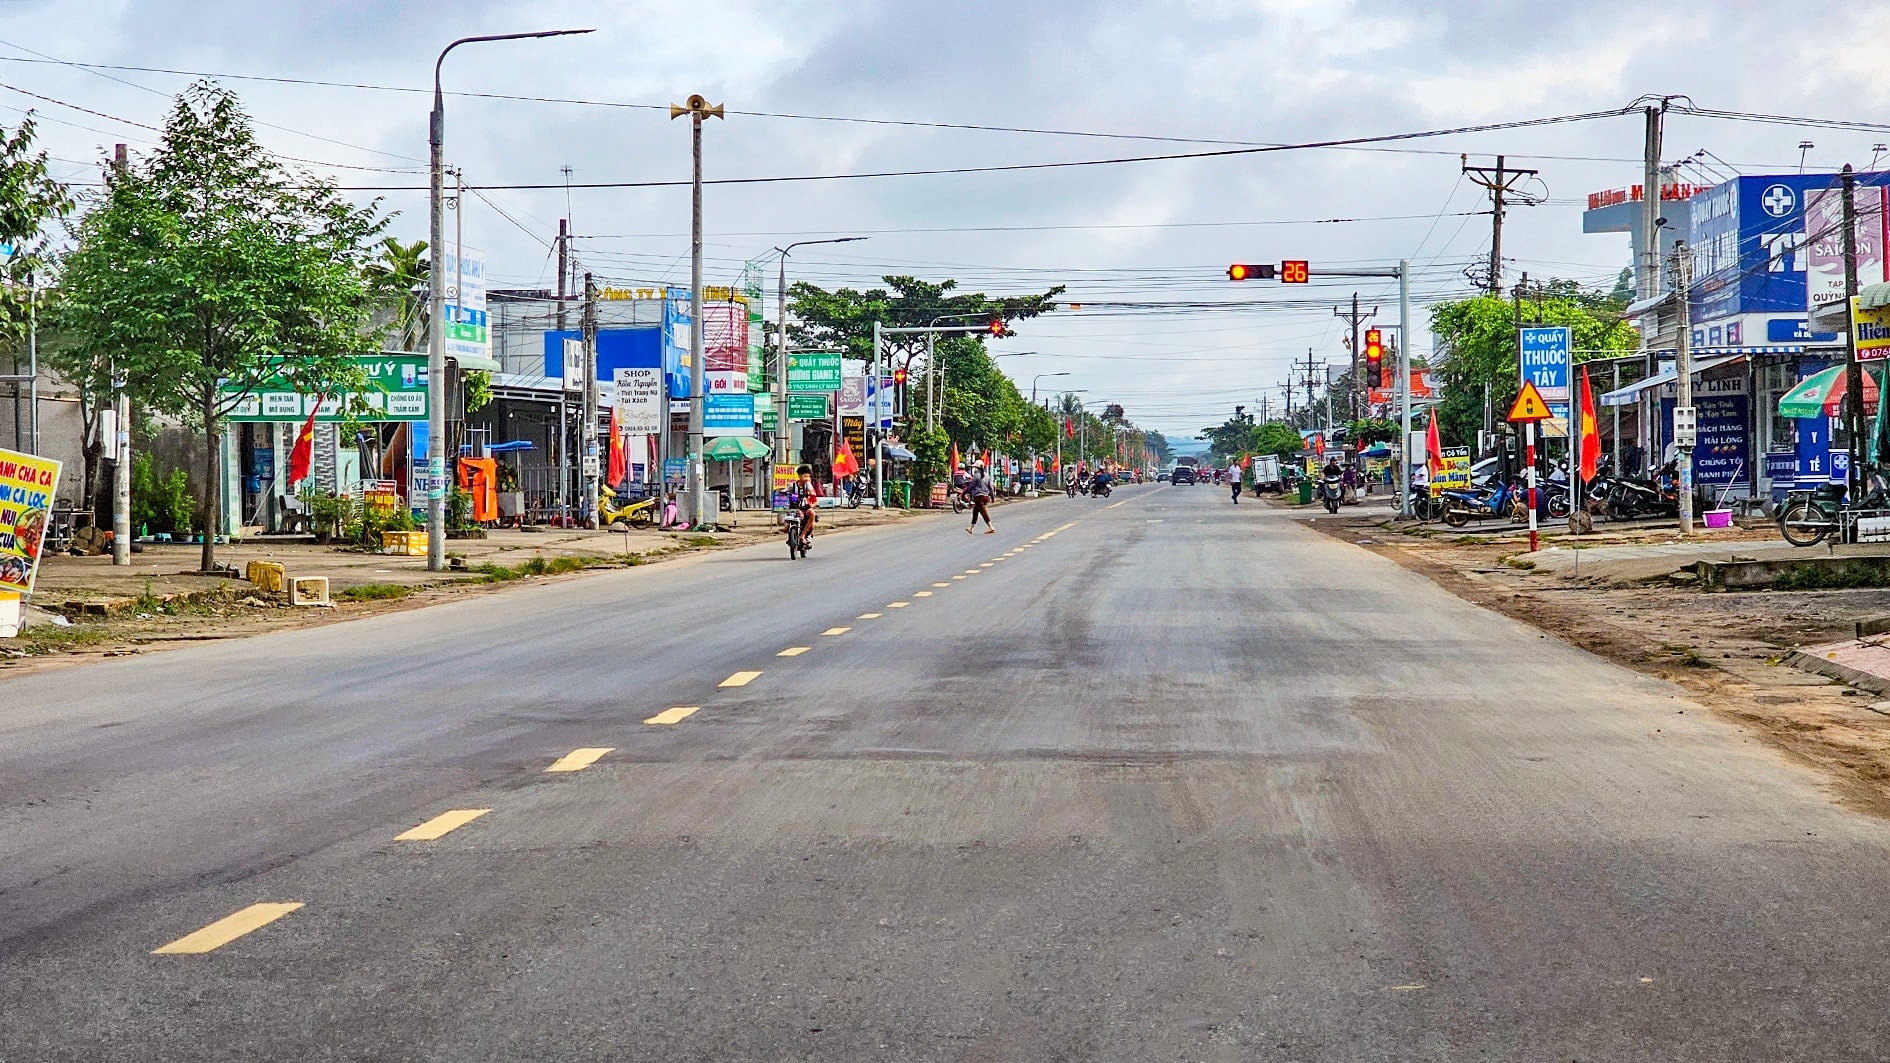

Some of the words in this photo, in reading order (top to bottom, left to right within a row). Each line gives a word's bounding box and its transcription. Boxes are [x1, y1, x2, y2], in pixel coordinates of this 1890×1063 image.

[1283, 263, 1306, 282] 26
[1368, 332, 1379, 342] 26
[1524, 344, 1565, 366] THUỐC
[384, 361, 396, 376] Ý
[834, 370, 840, 380] 2
[1533, 367, 1557, 386] TÂY
[714, 378, 727, 389] GÓI
[1709, 380, 1741, 391] LINH
[1720, 436, 1742, 444] LÒNG
[1811, 431, 1817, 443] Y
[1810, 455, 1820, 471] TẾ
